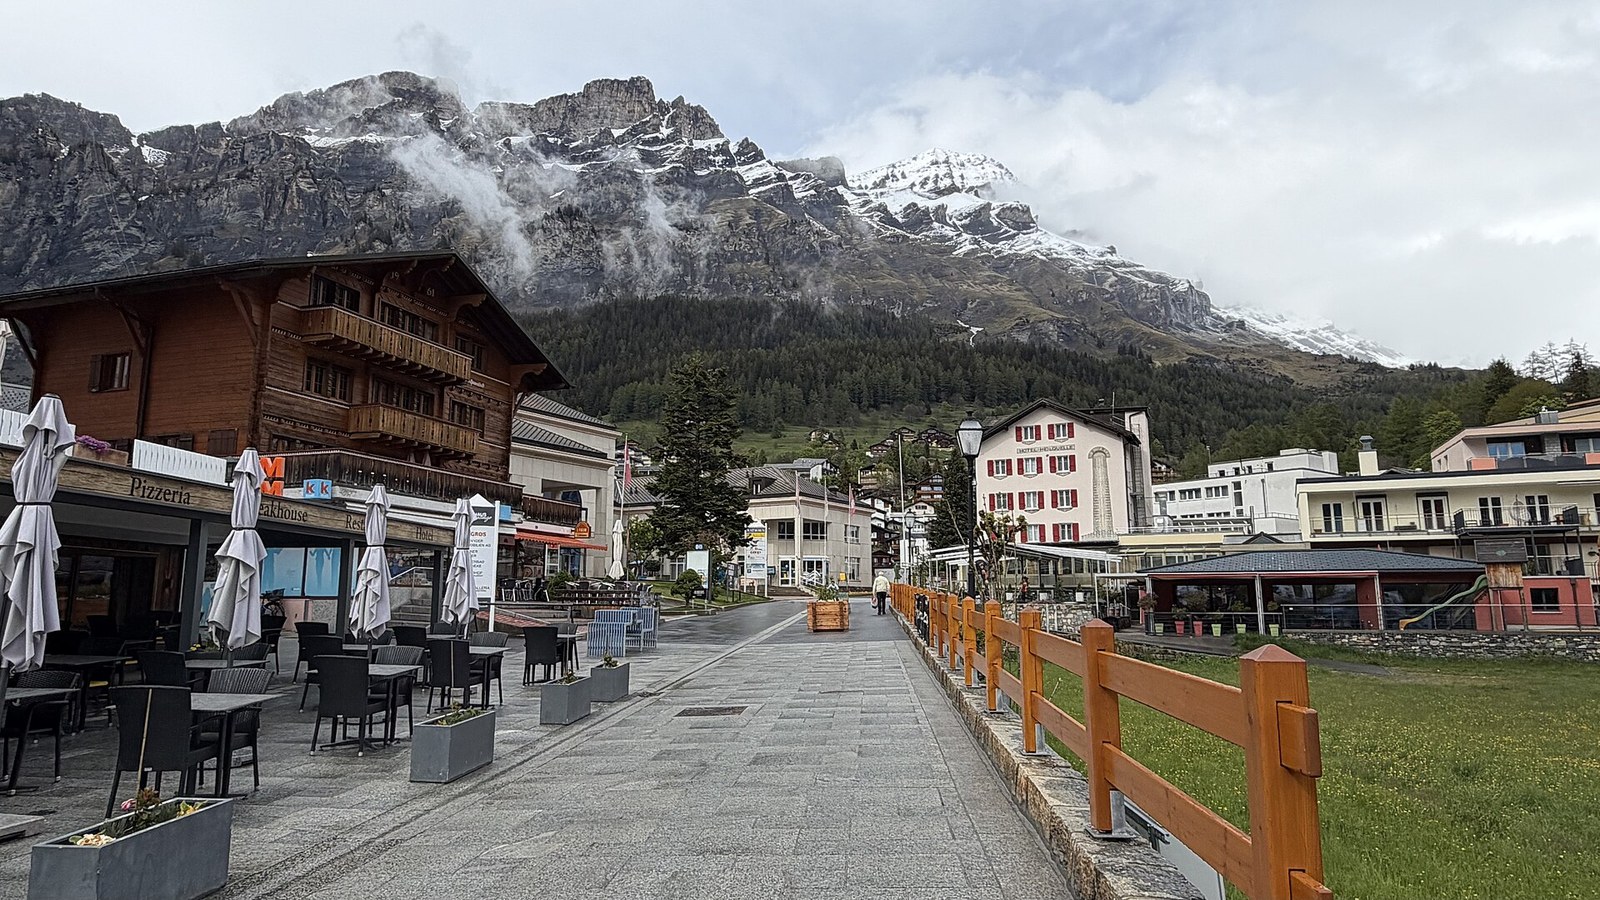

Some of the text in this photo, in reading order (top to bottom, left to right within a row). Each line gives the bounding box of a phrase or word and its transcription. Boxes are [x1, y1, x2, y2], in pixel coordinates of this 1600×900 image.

[426, 287, 435, 297] 61
[128, 475, 191, 505] Pizzeria
[259, 500, 308, 522] eakhouse
[345, 514, 366, 531] Rest
[415, 526, 434, 541] Hotel
